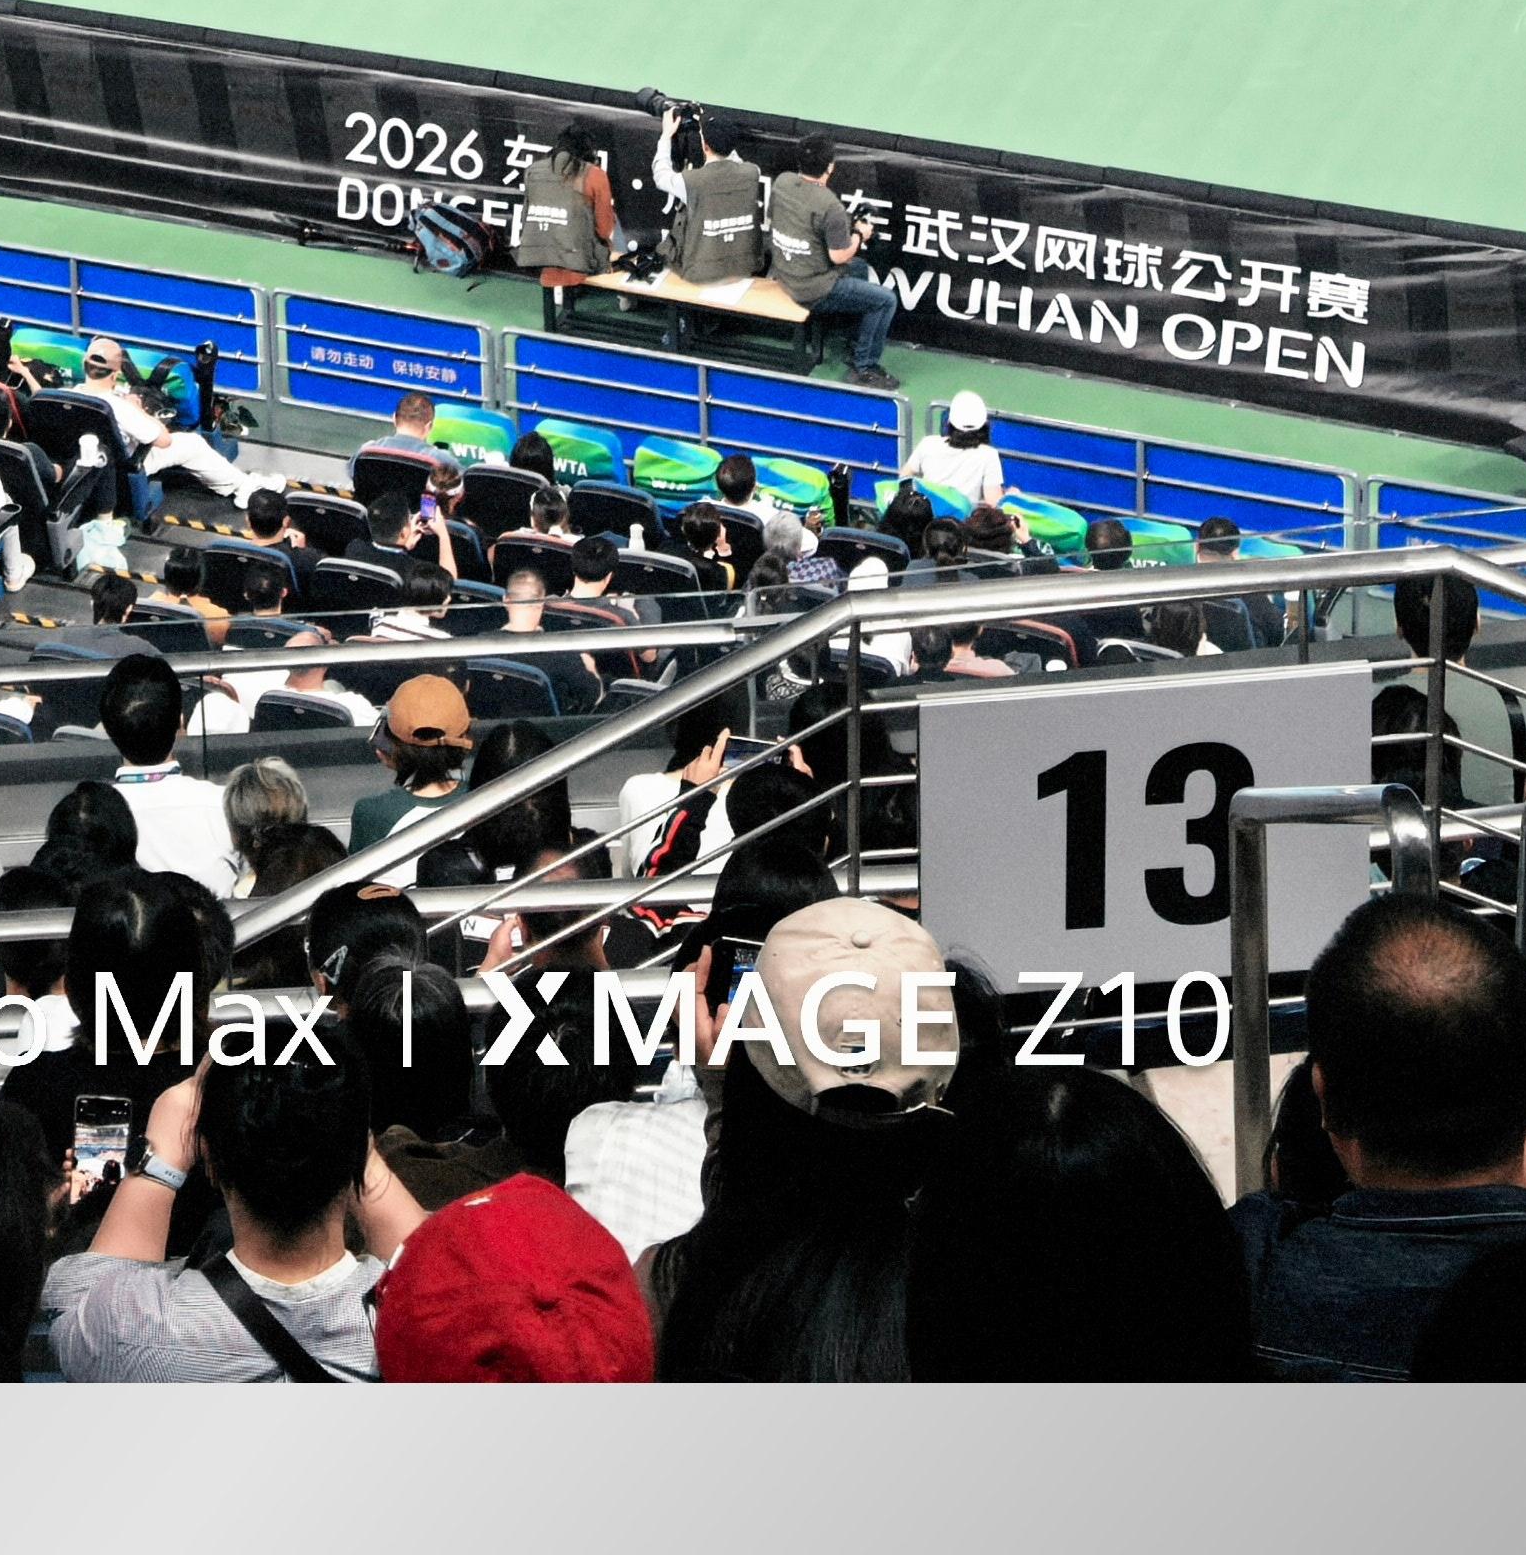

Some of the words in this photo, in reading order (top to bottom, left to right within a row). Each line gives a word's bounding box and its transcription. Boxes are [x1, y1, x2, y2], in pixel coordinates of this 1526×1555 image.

[344, 111, 485, 180] 2026
[864, 264, 1141, 350] WUHAN
[1161, 313, 1366, 389] OPEN
[311, 346, 374, 370] 请勿走动
[392, 359, 457, 384] 保持安静
[451, 442, 487, 460] WTA
[553, 457, 588, 477] WTA
[1037, 741, 1256, 931] 13
